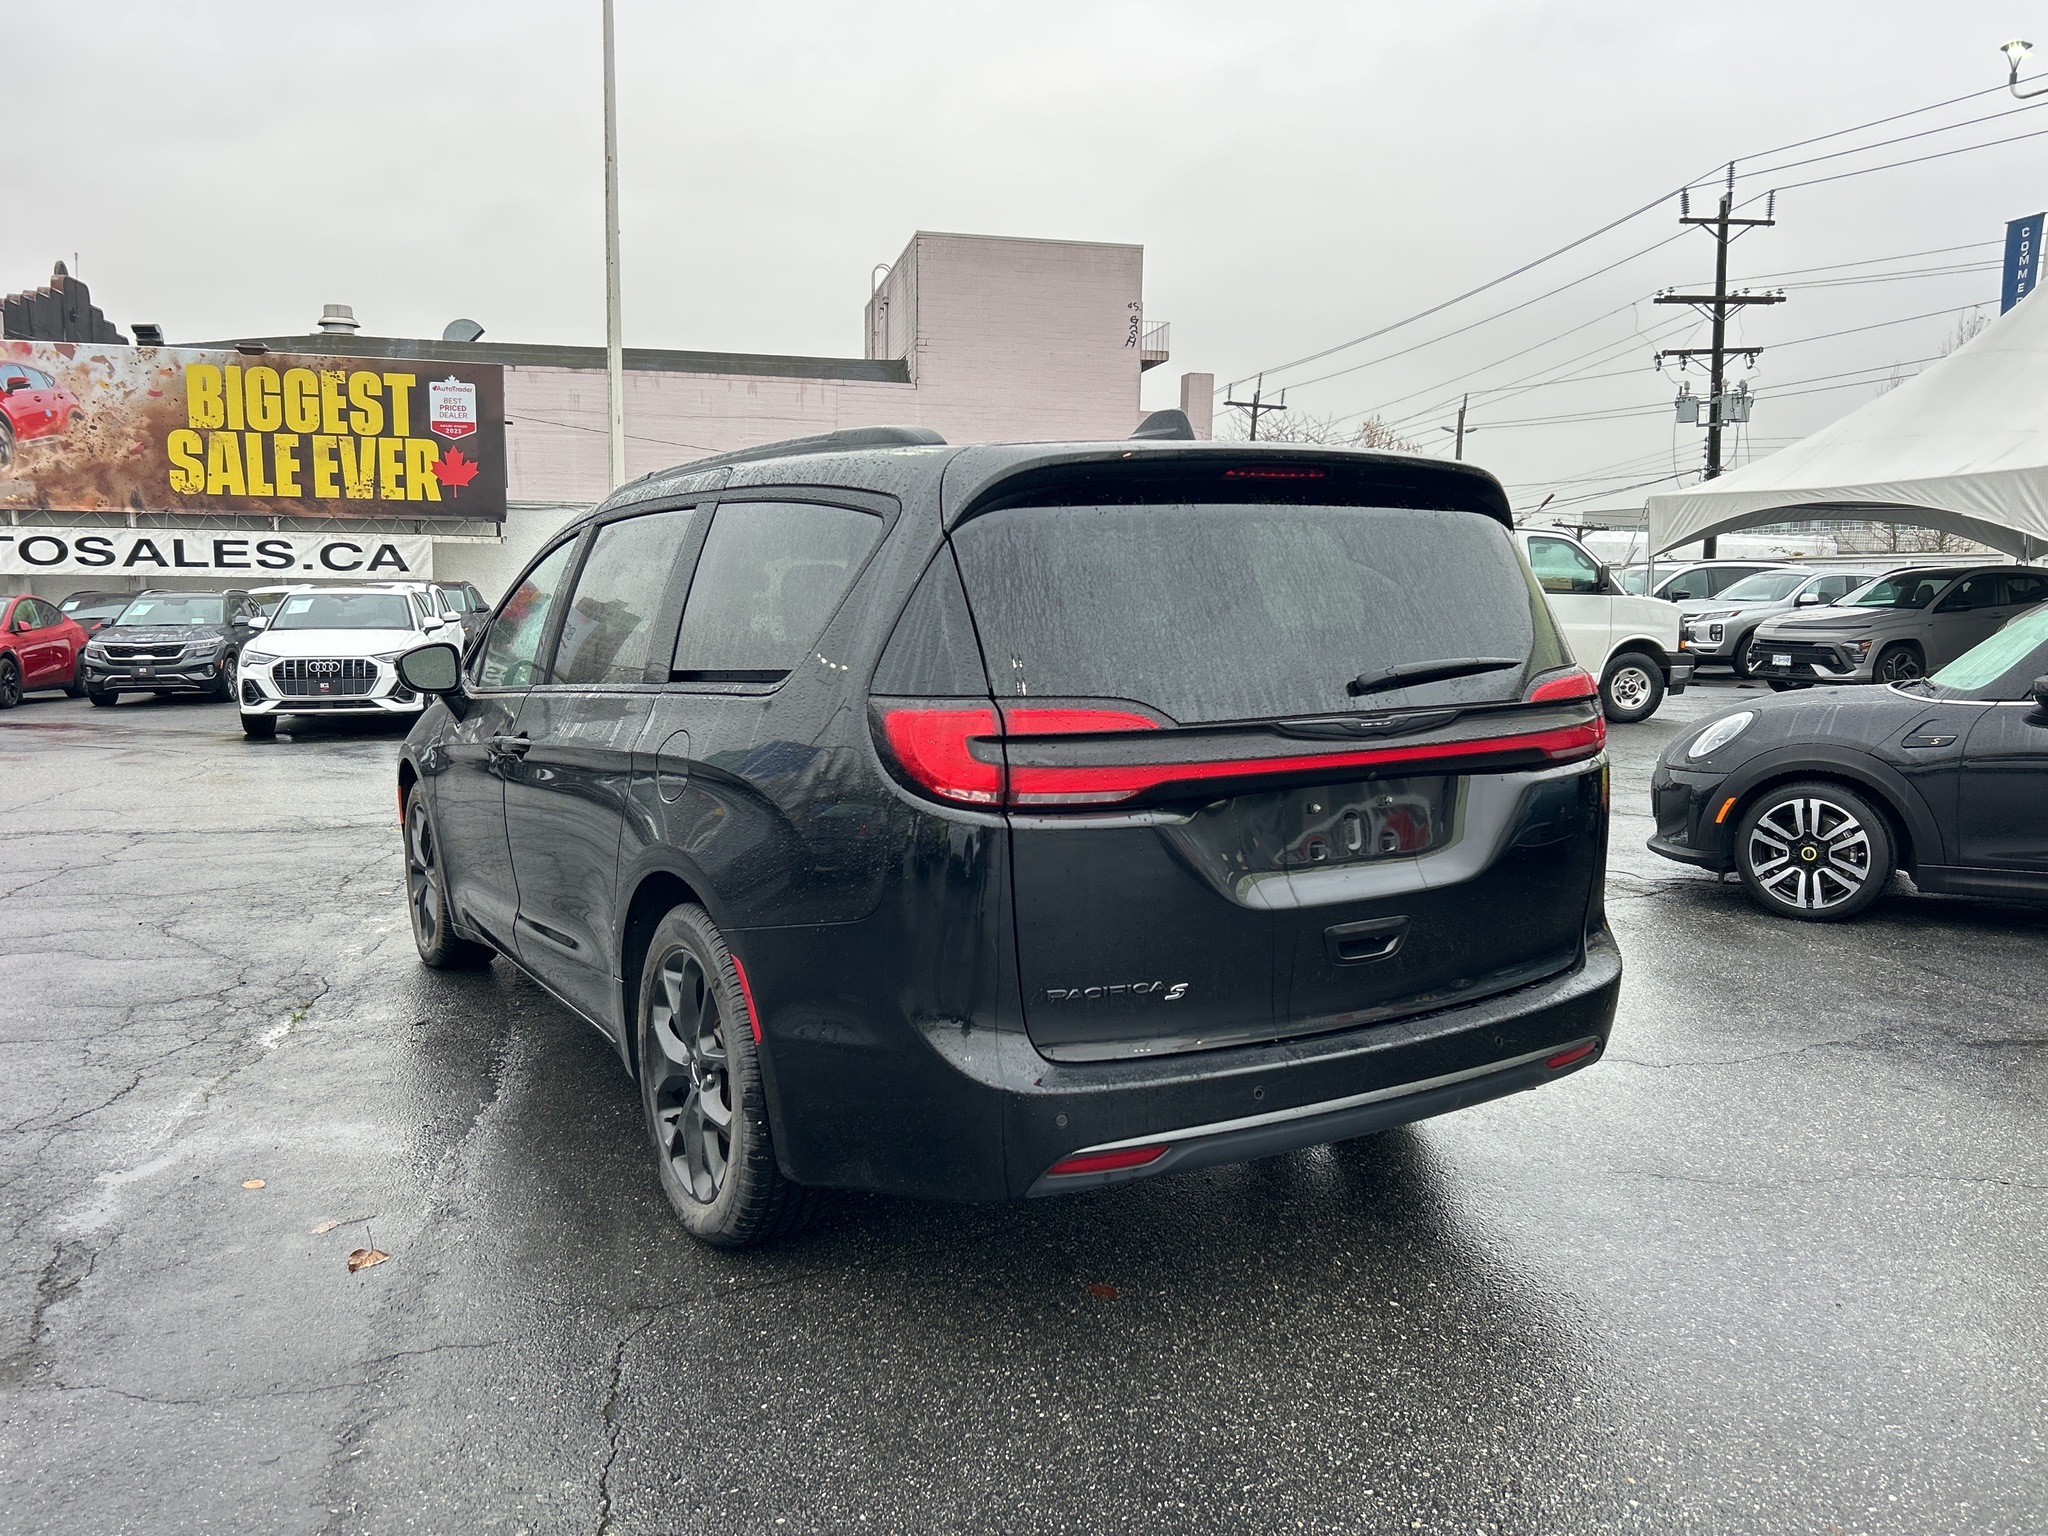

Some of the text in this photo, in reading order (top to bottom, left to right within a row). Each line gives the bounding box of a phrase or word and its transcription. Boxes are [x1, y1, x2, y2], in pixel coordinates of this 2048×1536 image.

[436, 385, 473, 393] AutoTrader
[185, 364, 416, 437] BIGGEST
[439, 404, 467, 412] PRICED
[439, 411, 468, 419] DEALER
[168, 430, 442, 501] SALE EVER
[1046, 980, 1167, 1003] PACIFICA
